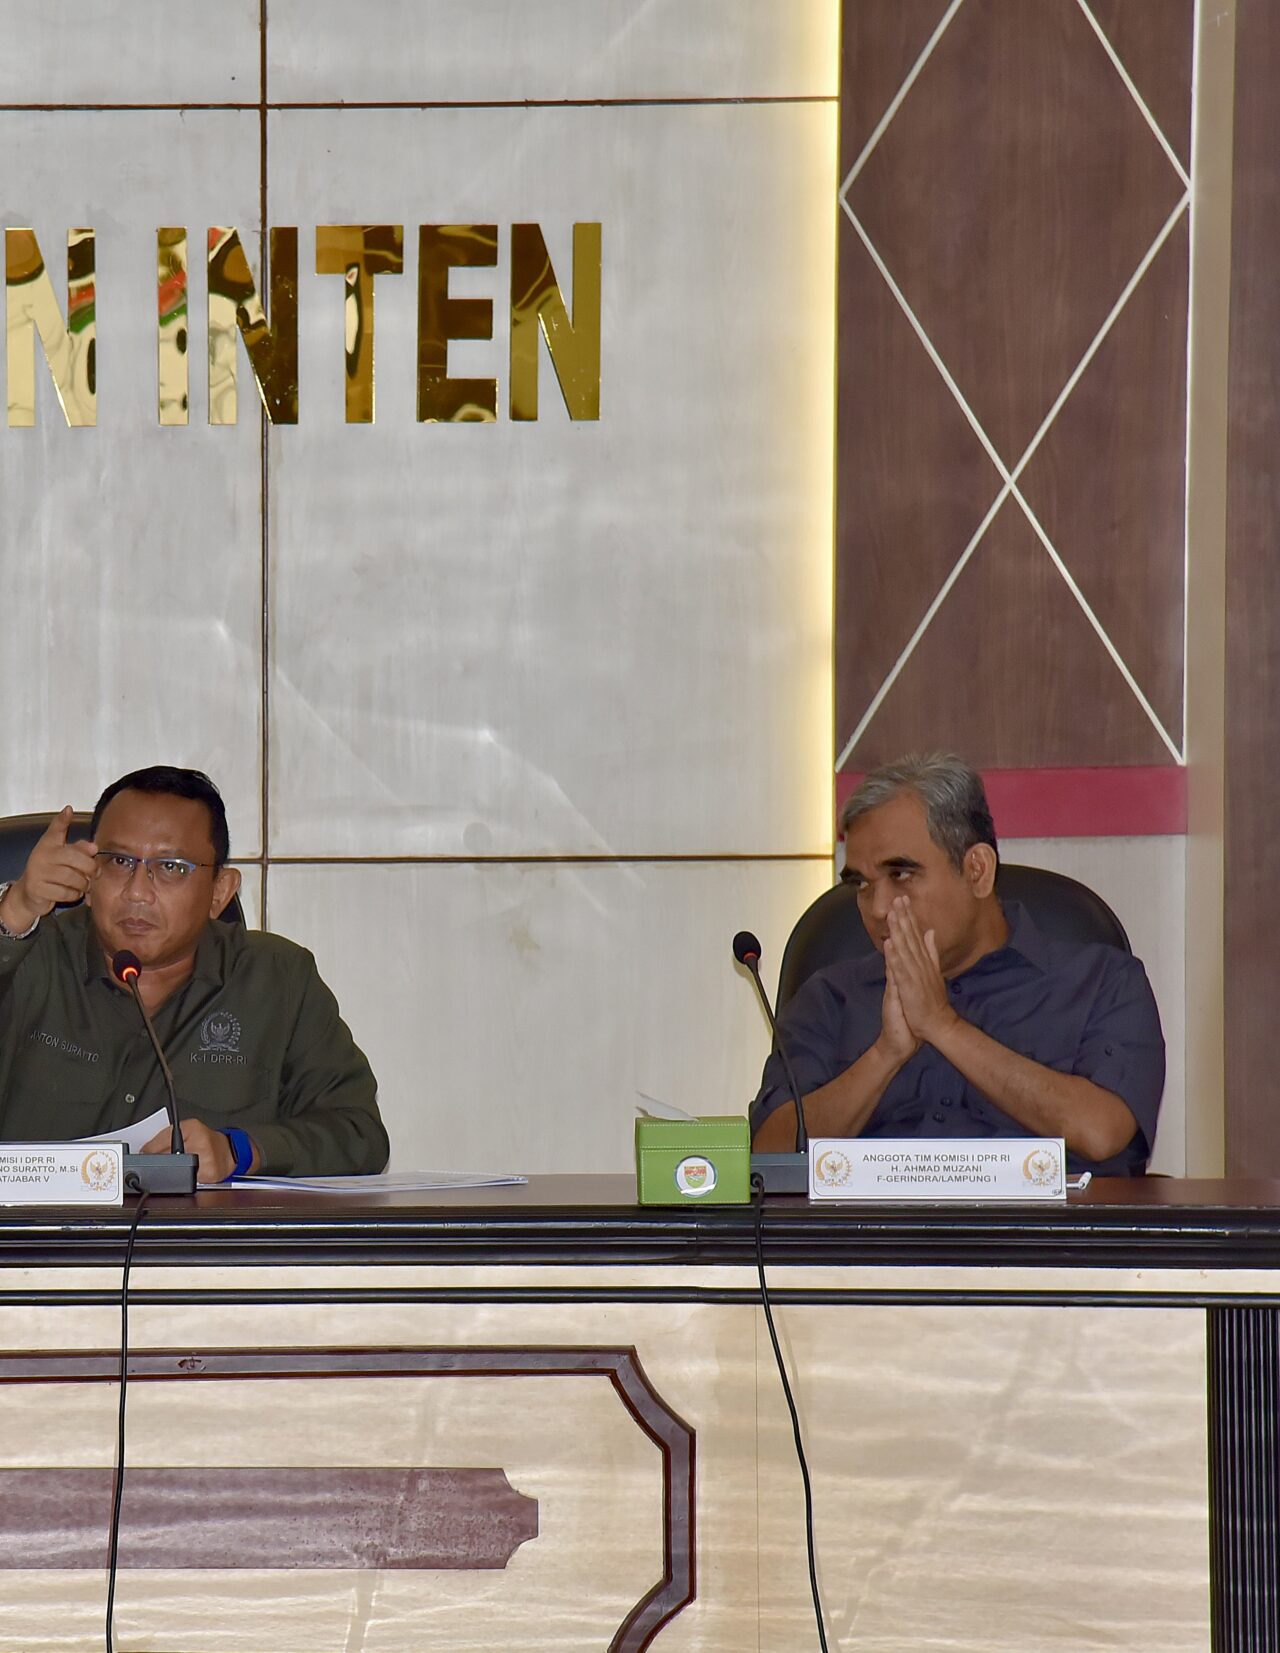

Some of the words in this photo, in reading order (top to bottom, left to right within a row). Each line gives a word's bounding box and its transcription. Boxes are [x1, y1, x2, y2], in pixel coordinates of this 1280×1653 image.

[157, 222, 601, 425] INTEN
[210, 1054, 248, 1064] DPR-RI
[862, 1154, 912, 1162] ANGGOTA
[914, 1154, 931, 1162] TIM
[934, 1154, 969, 1162] KOMISI
[977, 1154, 998, 1162] DPR
[1000, 1154, 1010, 1162] RI
[12, 1165, 57, 1173] SURATTO,
[876, 1175, 991, 1183] F-GERINDRA/LAMPUNG
